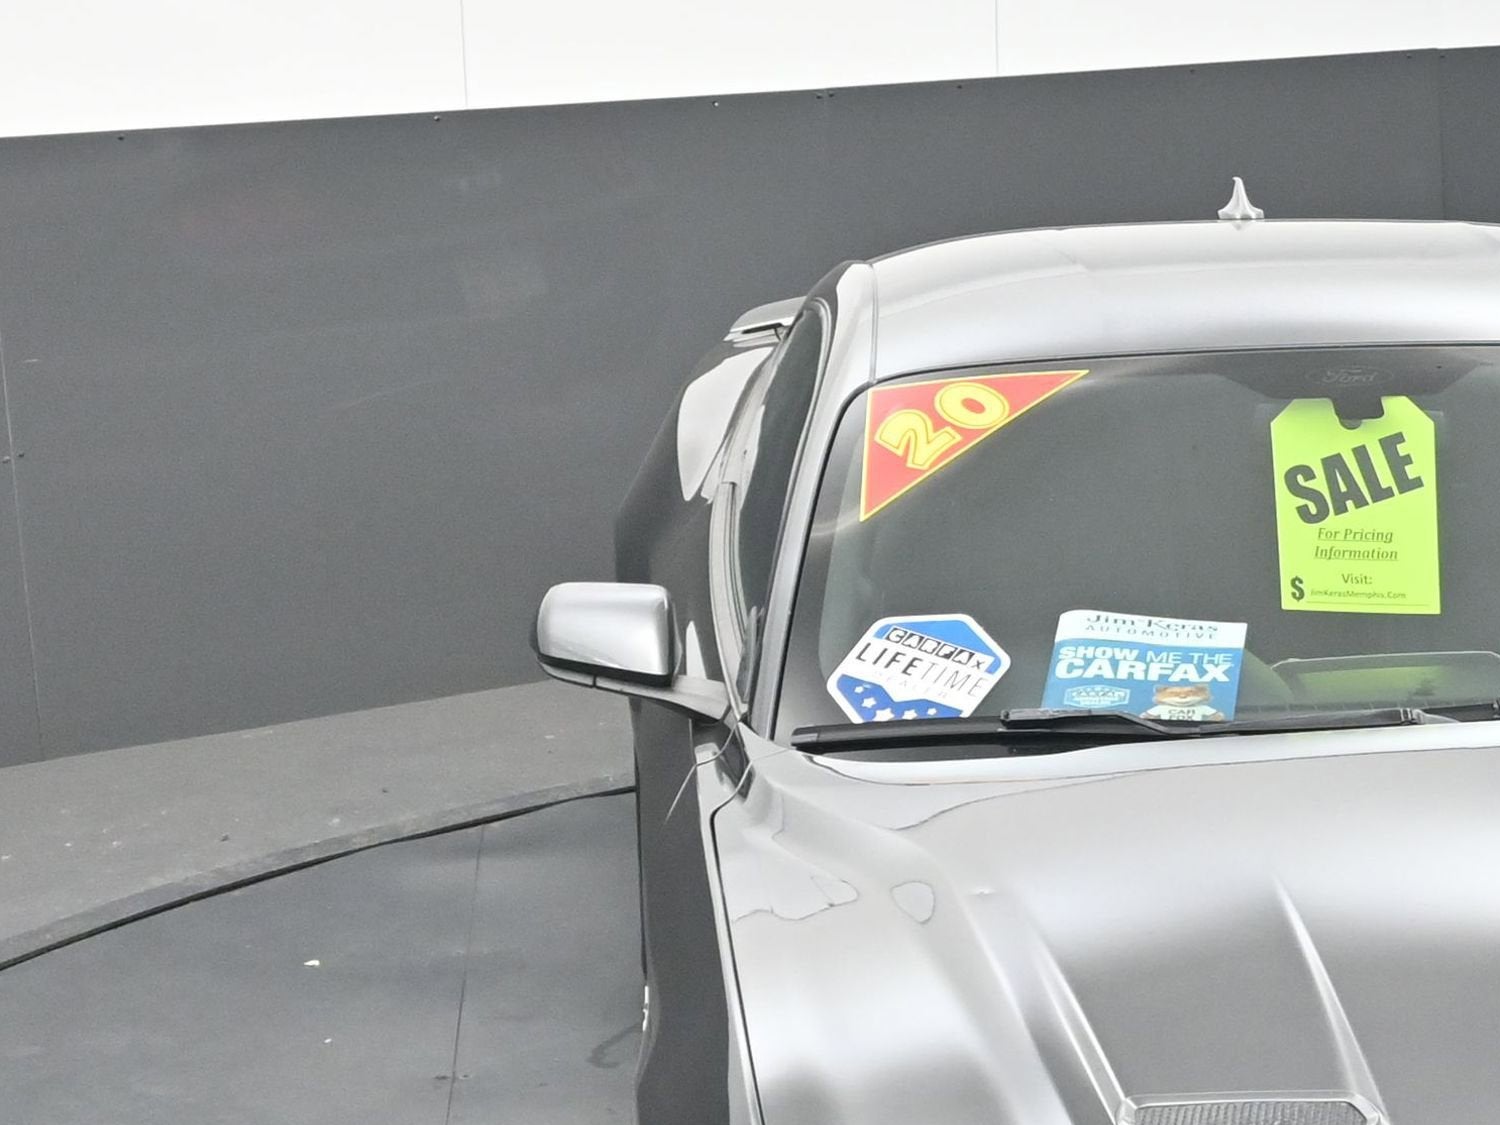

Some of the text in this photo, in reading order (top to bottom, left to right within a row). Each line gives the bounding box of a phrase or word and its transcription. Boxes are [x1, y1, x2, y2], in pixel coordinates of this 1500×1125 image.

[1321, 368, 1379, 384] Ford
[874, 382, 1010, 470] 20
[1284, 431, 1424, 524] SALE
[1317, 527, 1393, 543] For Pricing
[1313, 546, 1398, 560] Information
[1341, 573, 1372, 585] Visit:
[1290, 576, 1305, 602] $
[1085, 625, 1217, 640] AUTOMOTIVE
[1086, 614, 1218, 632] Jim Keras
[1058, 645, 1234, 666] SHOW ME THE
[856, 642, 990, 698] LIFETIME
[1055, 657, 1231, 682] CARFAX
